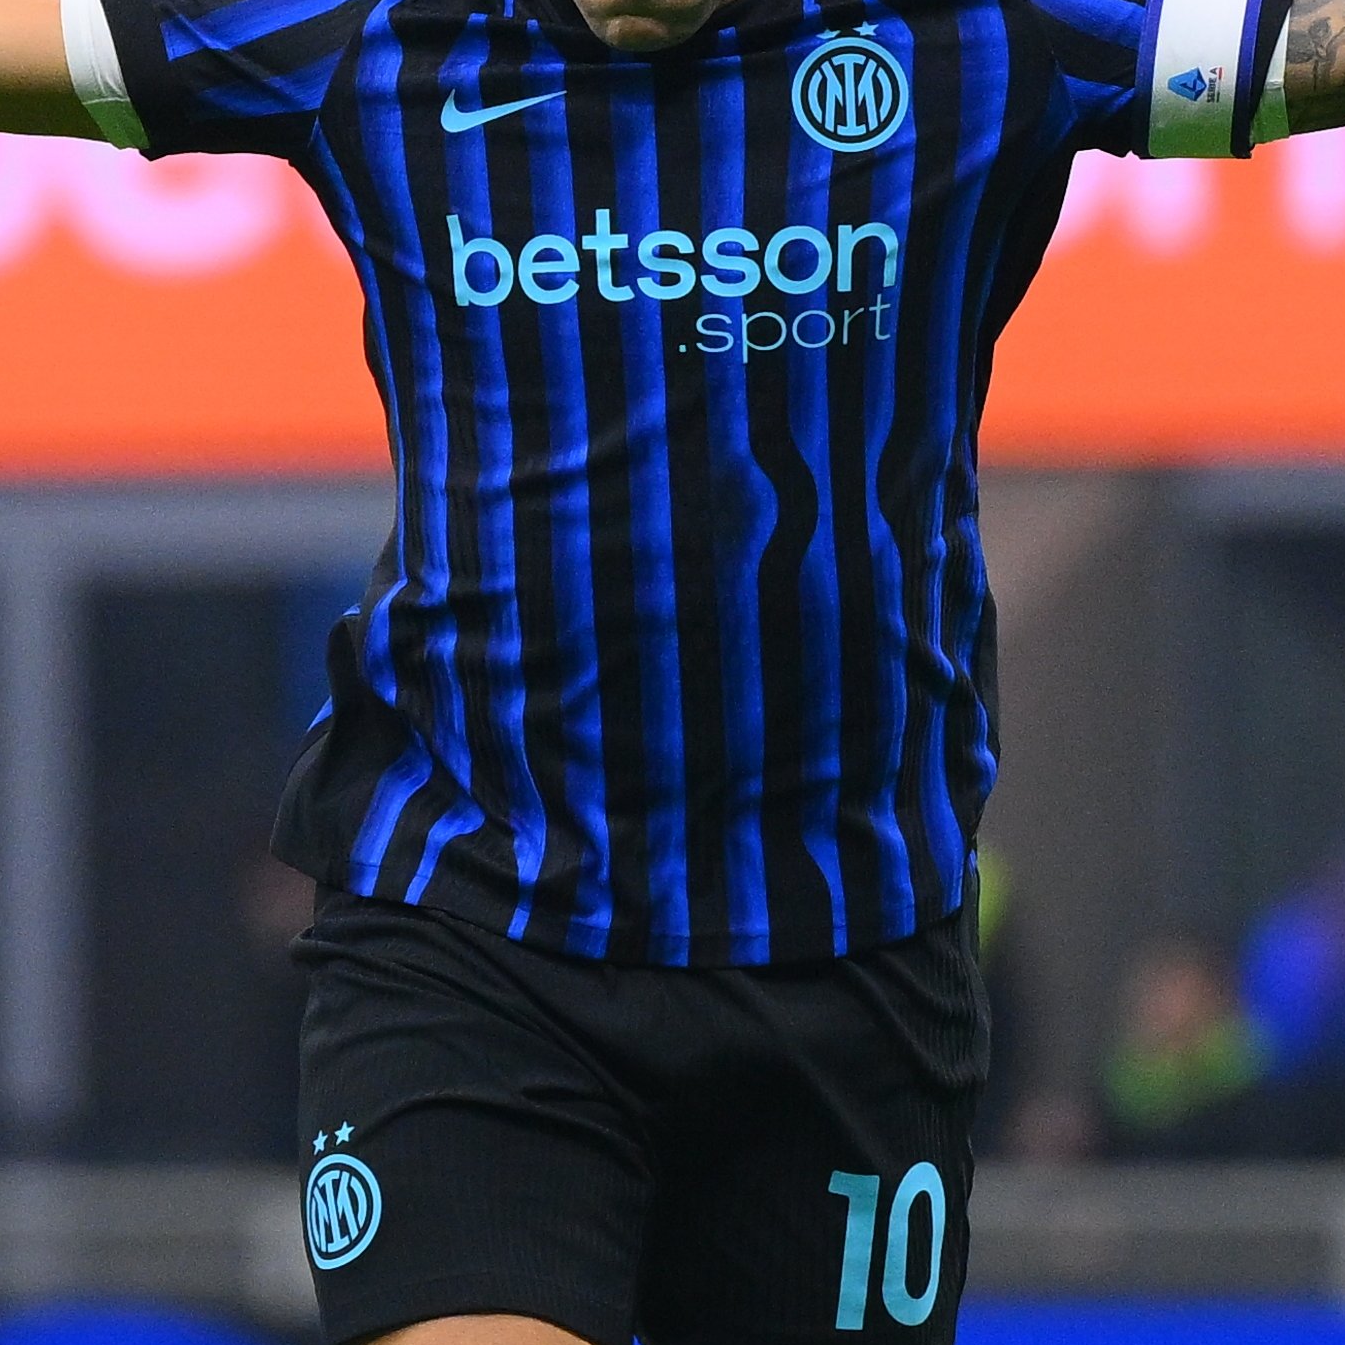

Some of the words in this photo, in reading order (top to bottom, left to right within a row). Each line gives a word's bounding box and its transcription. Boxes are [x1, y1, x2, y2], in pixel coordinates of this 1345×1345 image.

[446, 208, 899, 307] betsson
[678, 294, 892, 363] .sport
[828, 1161, 946, 1330] 10
